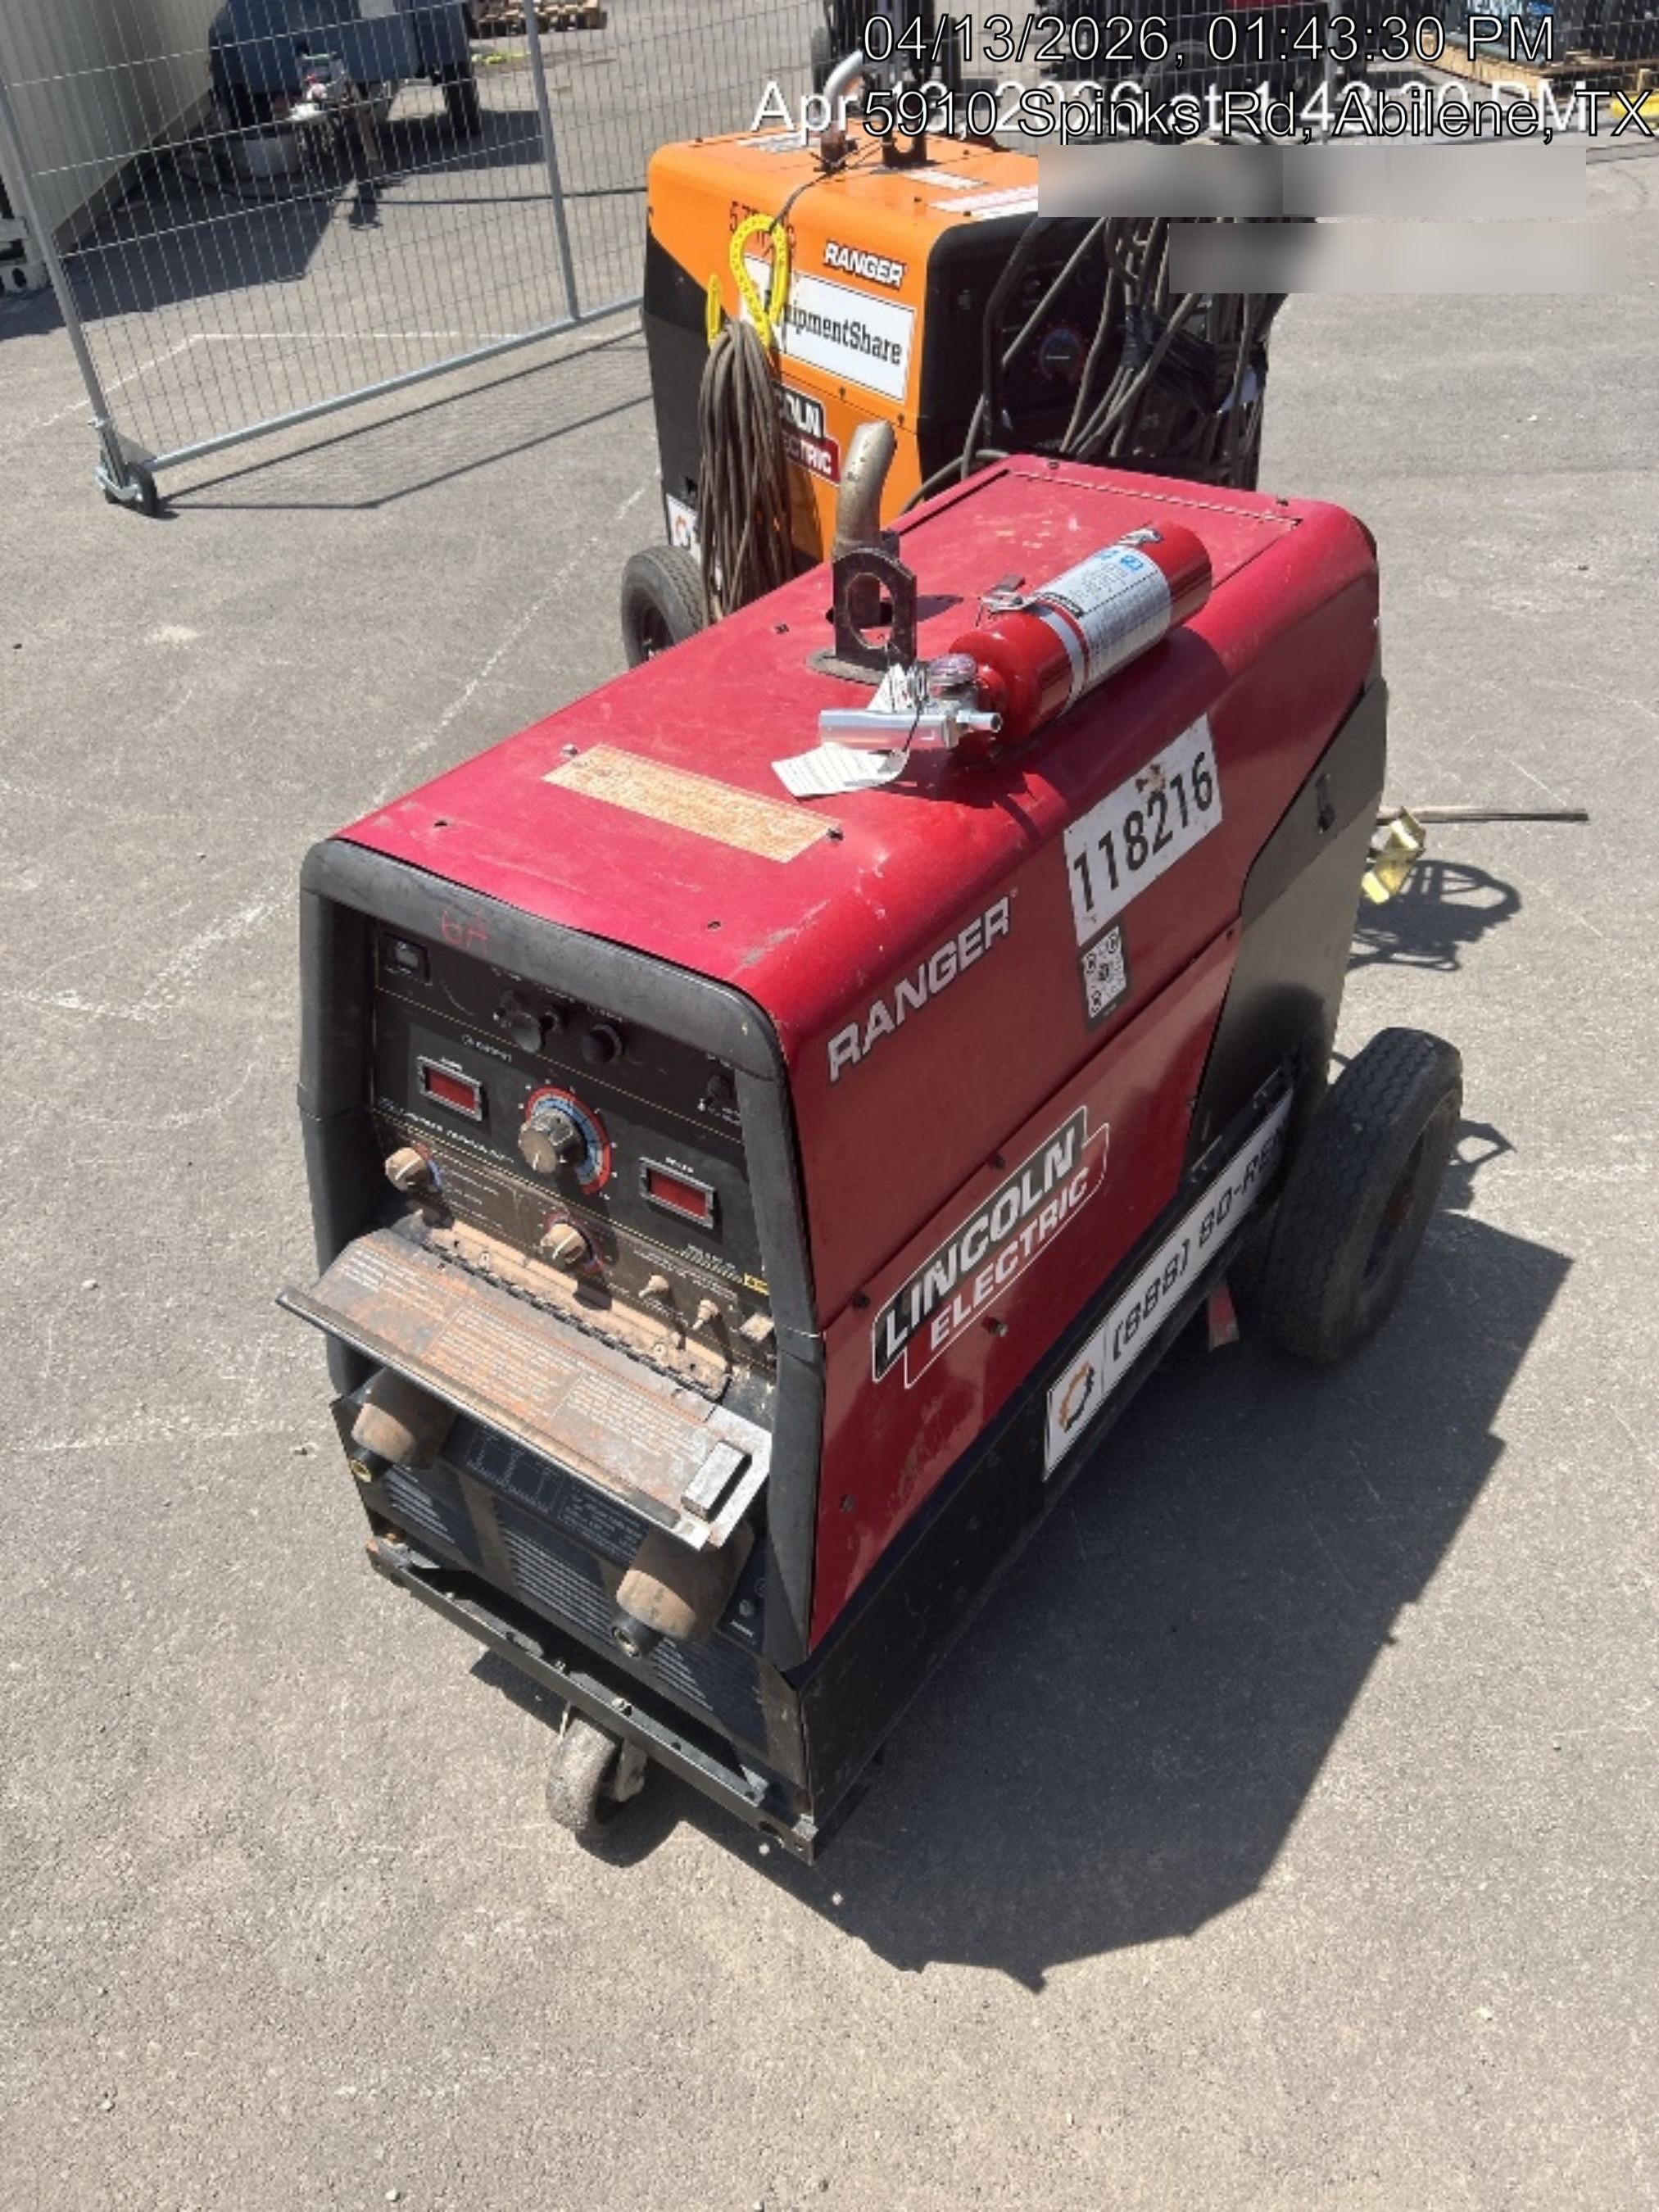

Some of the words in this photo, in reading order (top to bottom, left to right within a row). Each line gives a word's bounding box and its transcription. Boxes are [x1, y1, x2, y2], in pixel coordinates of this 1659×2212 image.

[823, 242, 903, 288] RANGER
[1074, 751, 1213, 912] 118216
[827, 896, 1010, 1082] RANGER
[884, 1126, 1075, 1360] LINCOLN
[929, 1167, 1090, 1349] ELECTRIC
[1113, 1238, 1190, 1362] (888)
